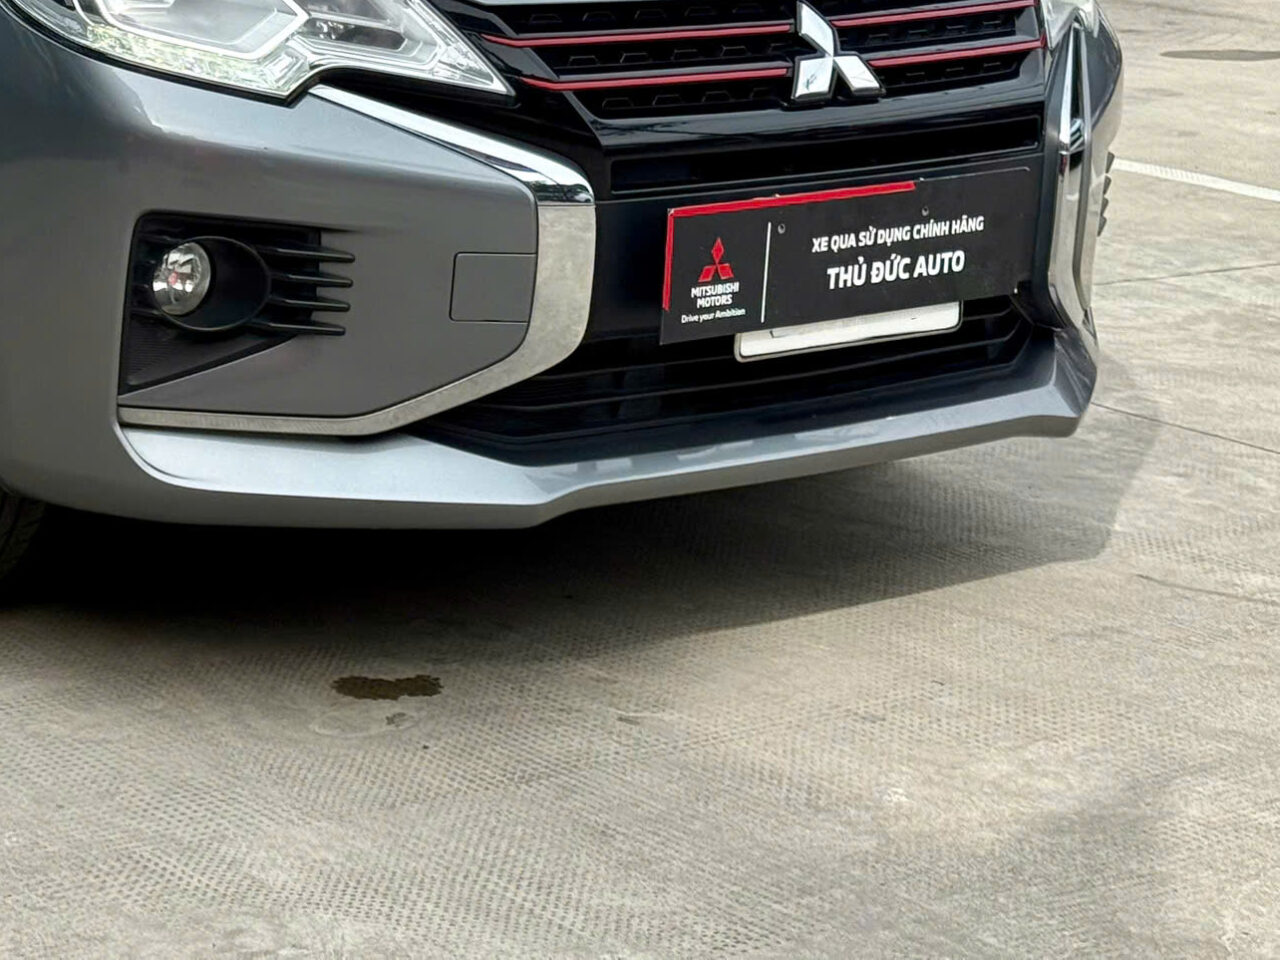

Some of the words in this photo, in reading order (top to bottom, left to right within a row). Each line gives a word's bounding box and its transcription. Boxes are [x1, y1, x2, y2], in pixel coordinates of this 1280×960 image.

[811, 236, 829, 253] XE
[830, 232, 857, 253] QUA
[858, 225, 876, 247] SỬ
[877, 225, 911, 247] DỤNG
[913, 218, 950, 240] CHÍNH
[951, 214, 985, 235] HÃNG
[826, 255, 868, 290] THỦ
[870, 252, 912, 284] ĐỨC
[913, 249, 966, 279] AUTO
[690, 281, 740, 299] MITSUBISHI
[696, 294, 733, 309] MOTORS
[681, 314, 699, 324] Drive
[699, 312, 715, 323] your
[715, 307, 746, 319] Ambition
